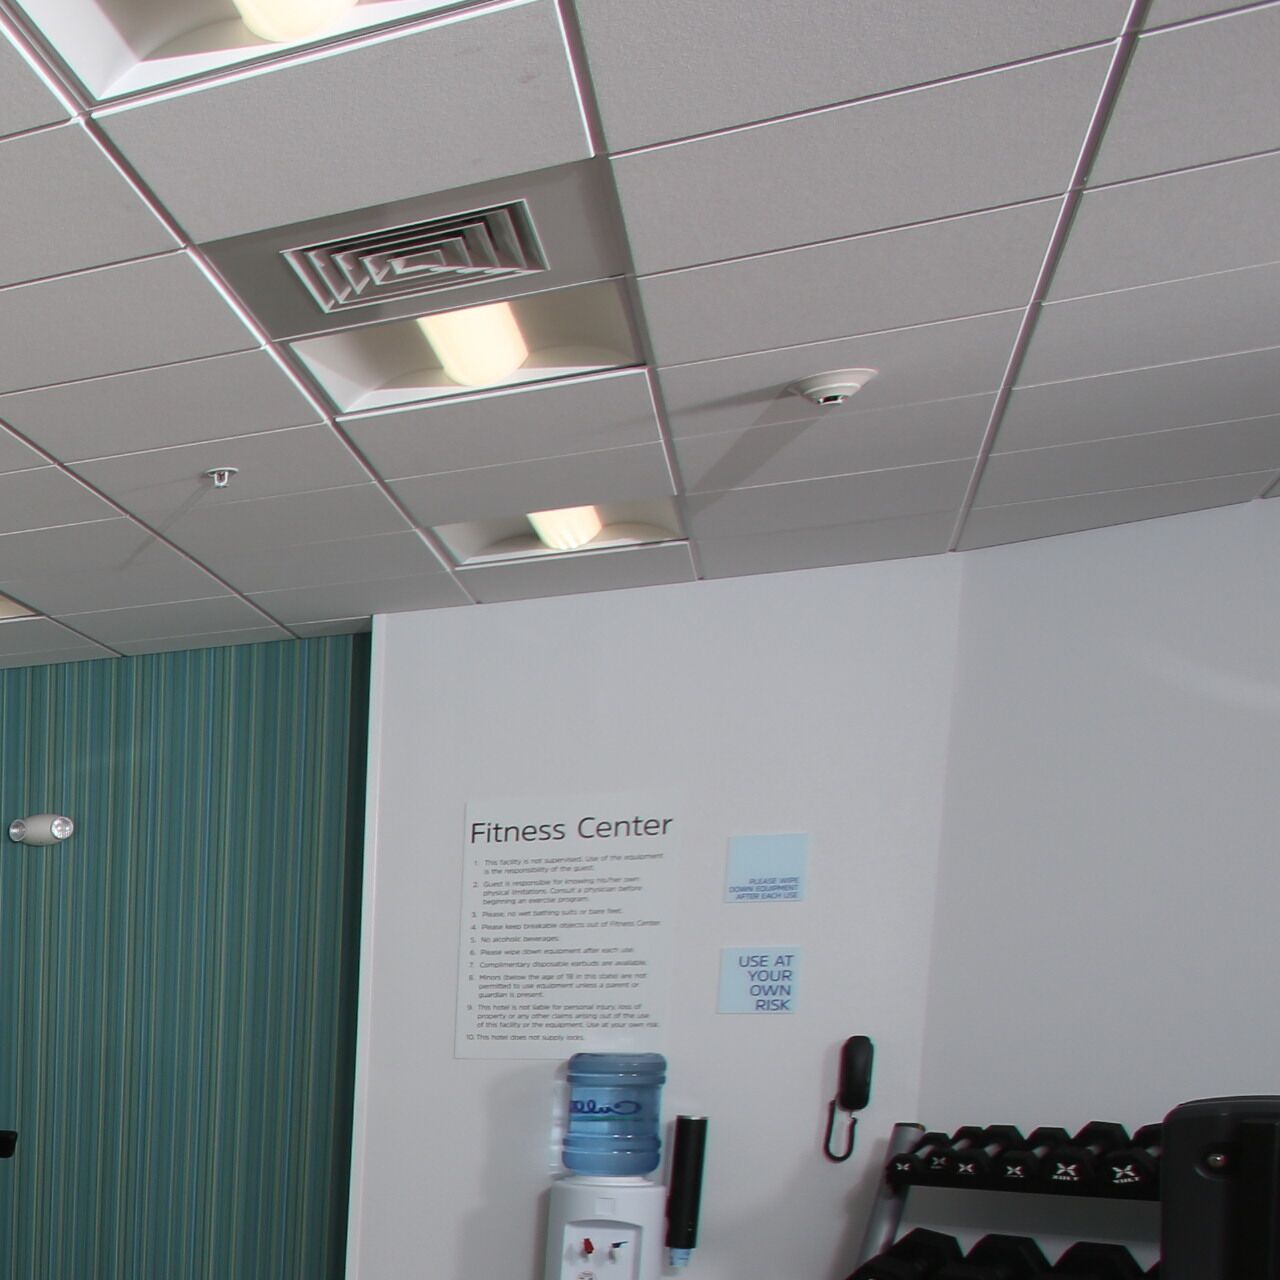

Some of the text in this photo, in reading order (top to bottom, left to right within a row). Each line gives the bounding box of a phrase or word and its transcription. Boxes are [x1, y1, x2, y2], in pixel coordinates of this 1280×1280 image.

[471, 816, 673, 843] Fitness Center
[749, 877, 777, 885] PLEASE
[729, 885, 753, 893] DOWN
[736, 892, 759, 900] AFTER
[739, 955, 794, 967] USE AT
[748, 970, 792, 981] YOUR
[750, 985, 791, 996] OWN
[756, 1000, 790, 1011] RISK
